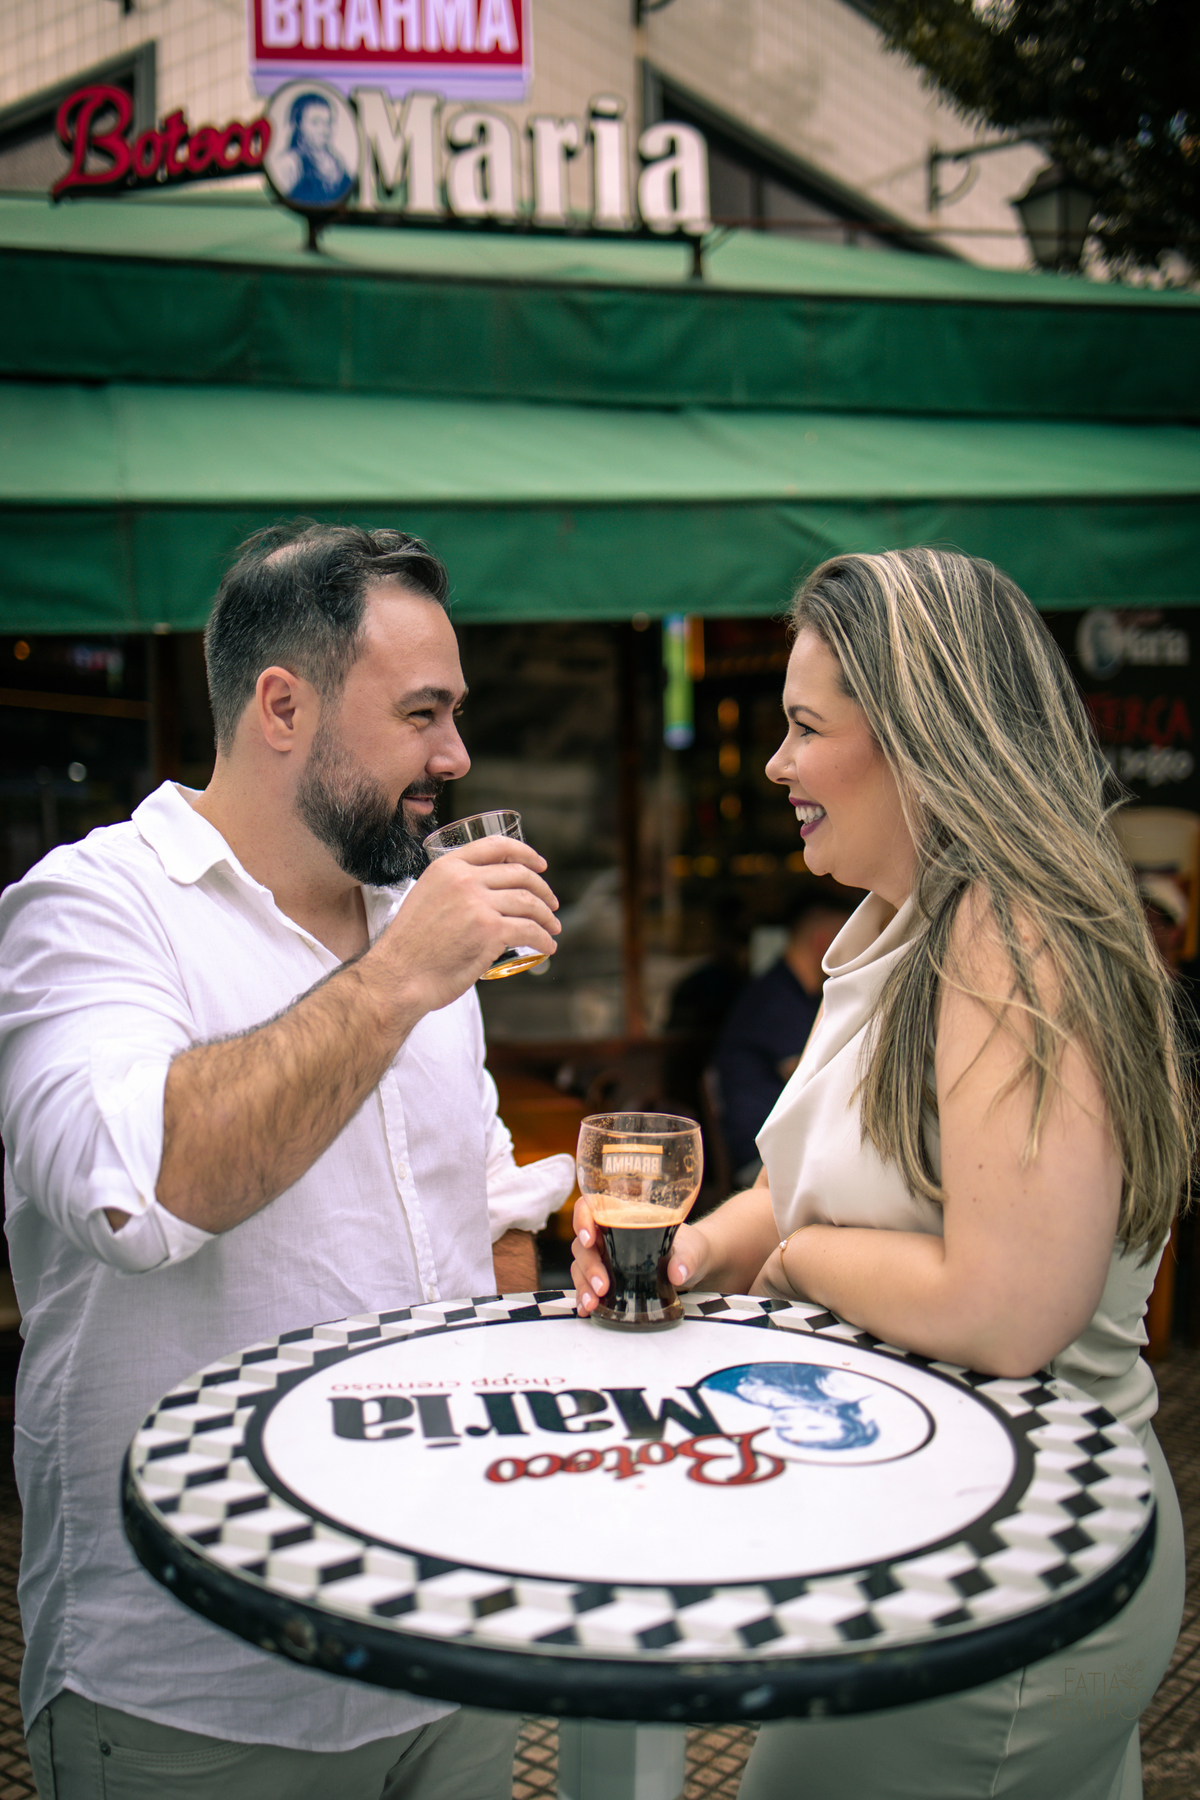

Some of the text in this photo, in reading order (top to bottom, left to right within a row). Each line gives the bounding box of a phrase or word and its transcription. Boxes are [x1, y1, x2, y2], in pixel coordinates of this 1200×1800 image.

[260, 0, 519, 54] BRAHMA
[52, 83, 712, 236] Boteco Maria
[330, 1376, 566, 1392] chopp cremoso
[327, 1385, 723, 1448] Maria
[485, 1426, 787, 1486] Boteco
